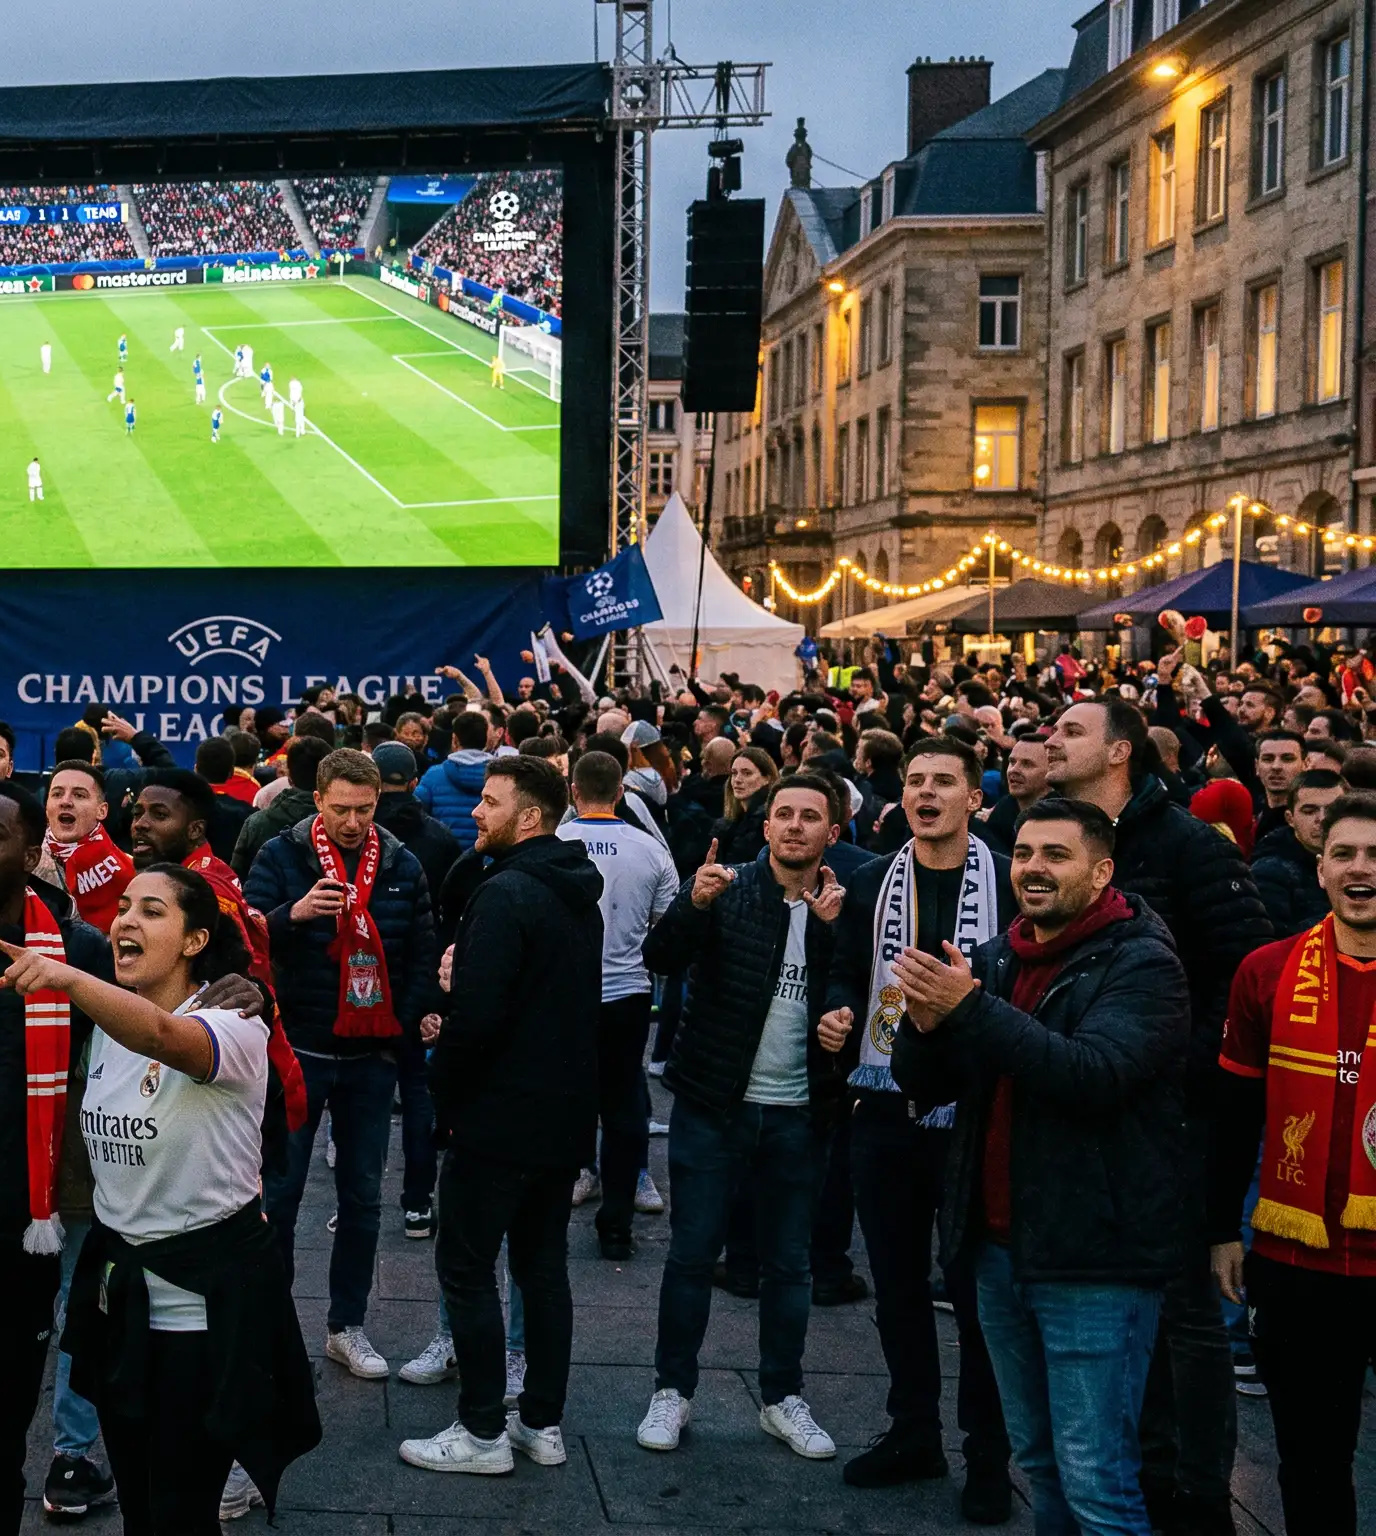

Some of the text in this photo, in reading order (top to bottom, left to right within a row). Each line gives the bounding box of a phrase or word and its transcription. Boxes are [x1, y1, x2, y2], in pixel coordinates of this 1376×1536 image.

[39, 209, 46, 221] 1
[62, 207, 69, 220] 1
[97, 269, 186, 287] mastercard
[222, 263, 302, 284] Heineken
[176, 624, 271, 660] UEFA
[17, 673, 265, 705] CHAMPIONS
[102, 1141, 146, 1167] BETTER
